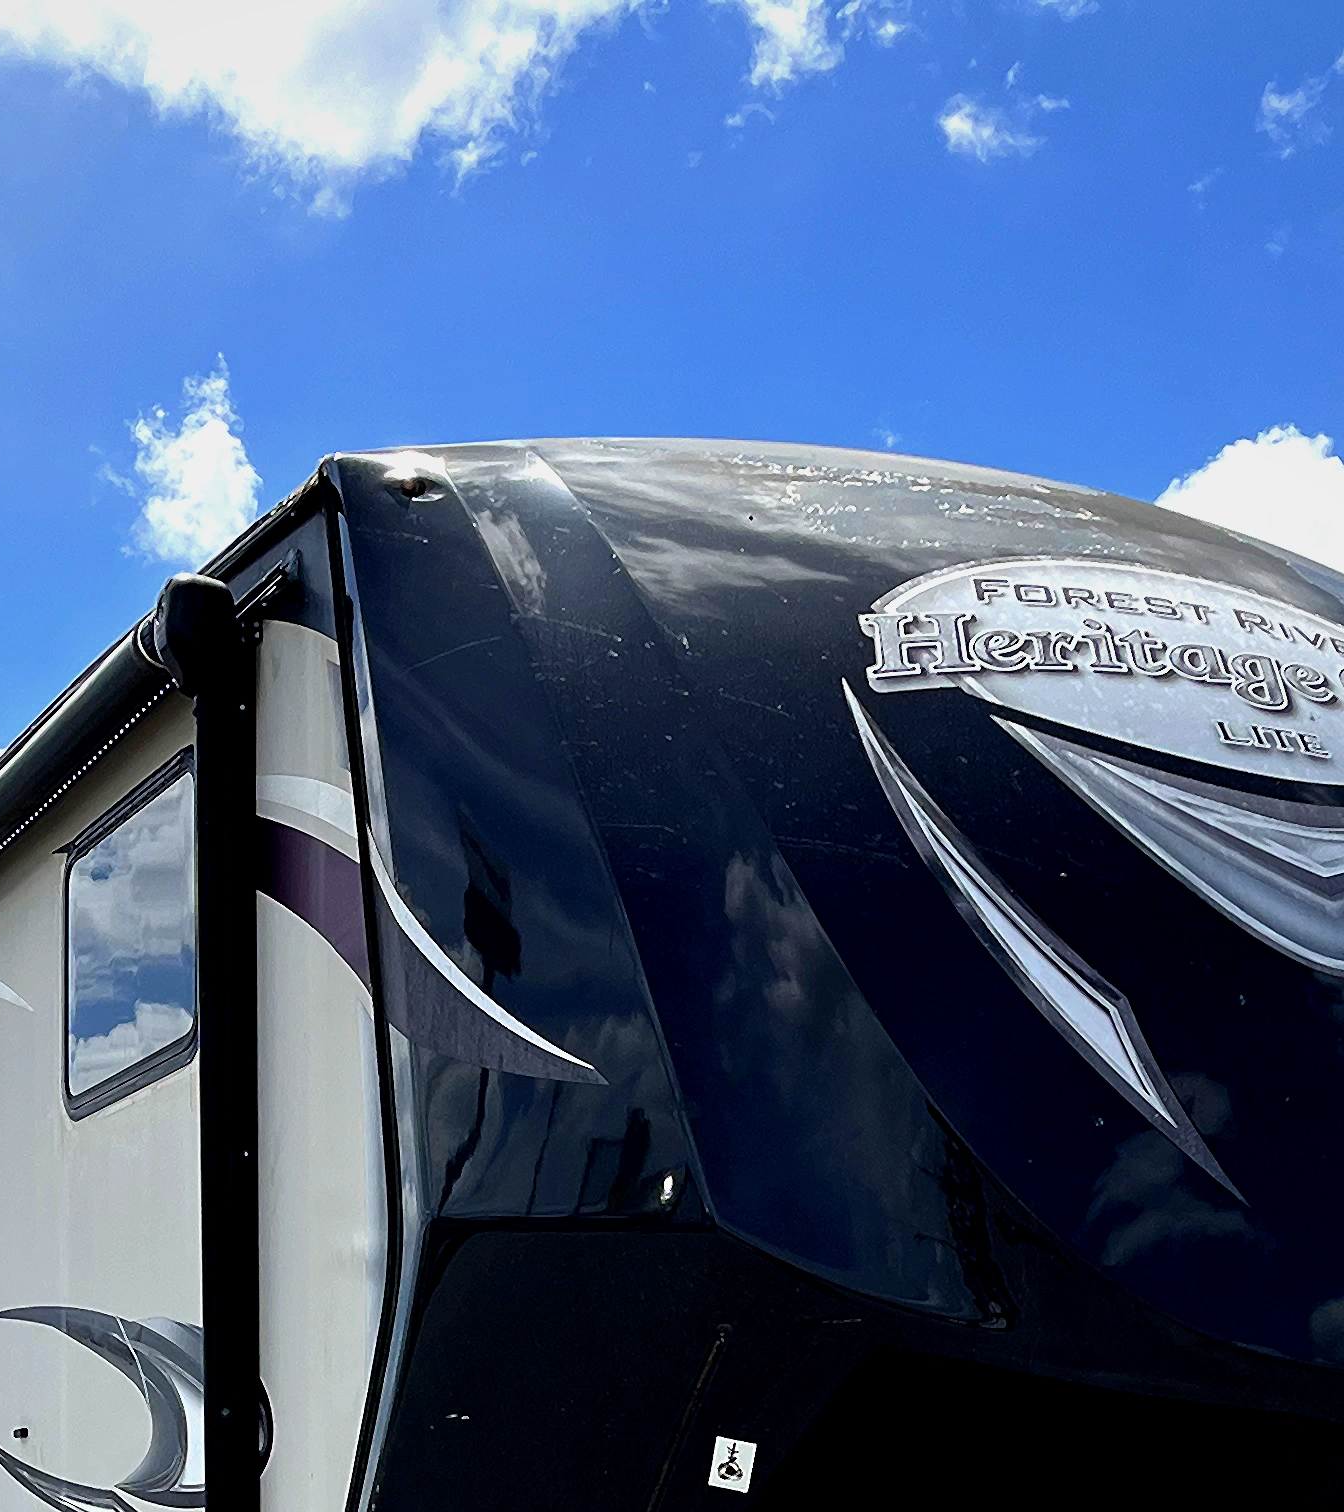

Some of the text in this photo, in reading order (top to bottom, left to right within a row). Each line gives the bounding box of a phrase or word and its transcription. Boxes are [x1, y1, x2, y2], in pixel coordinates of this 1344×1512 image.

[970, 577, 1215, 624] FOREST
[858, 612, 1338, 712] Heritage
[1213, 719, 1334, 760] LITE
